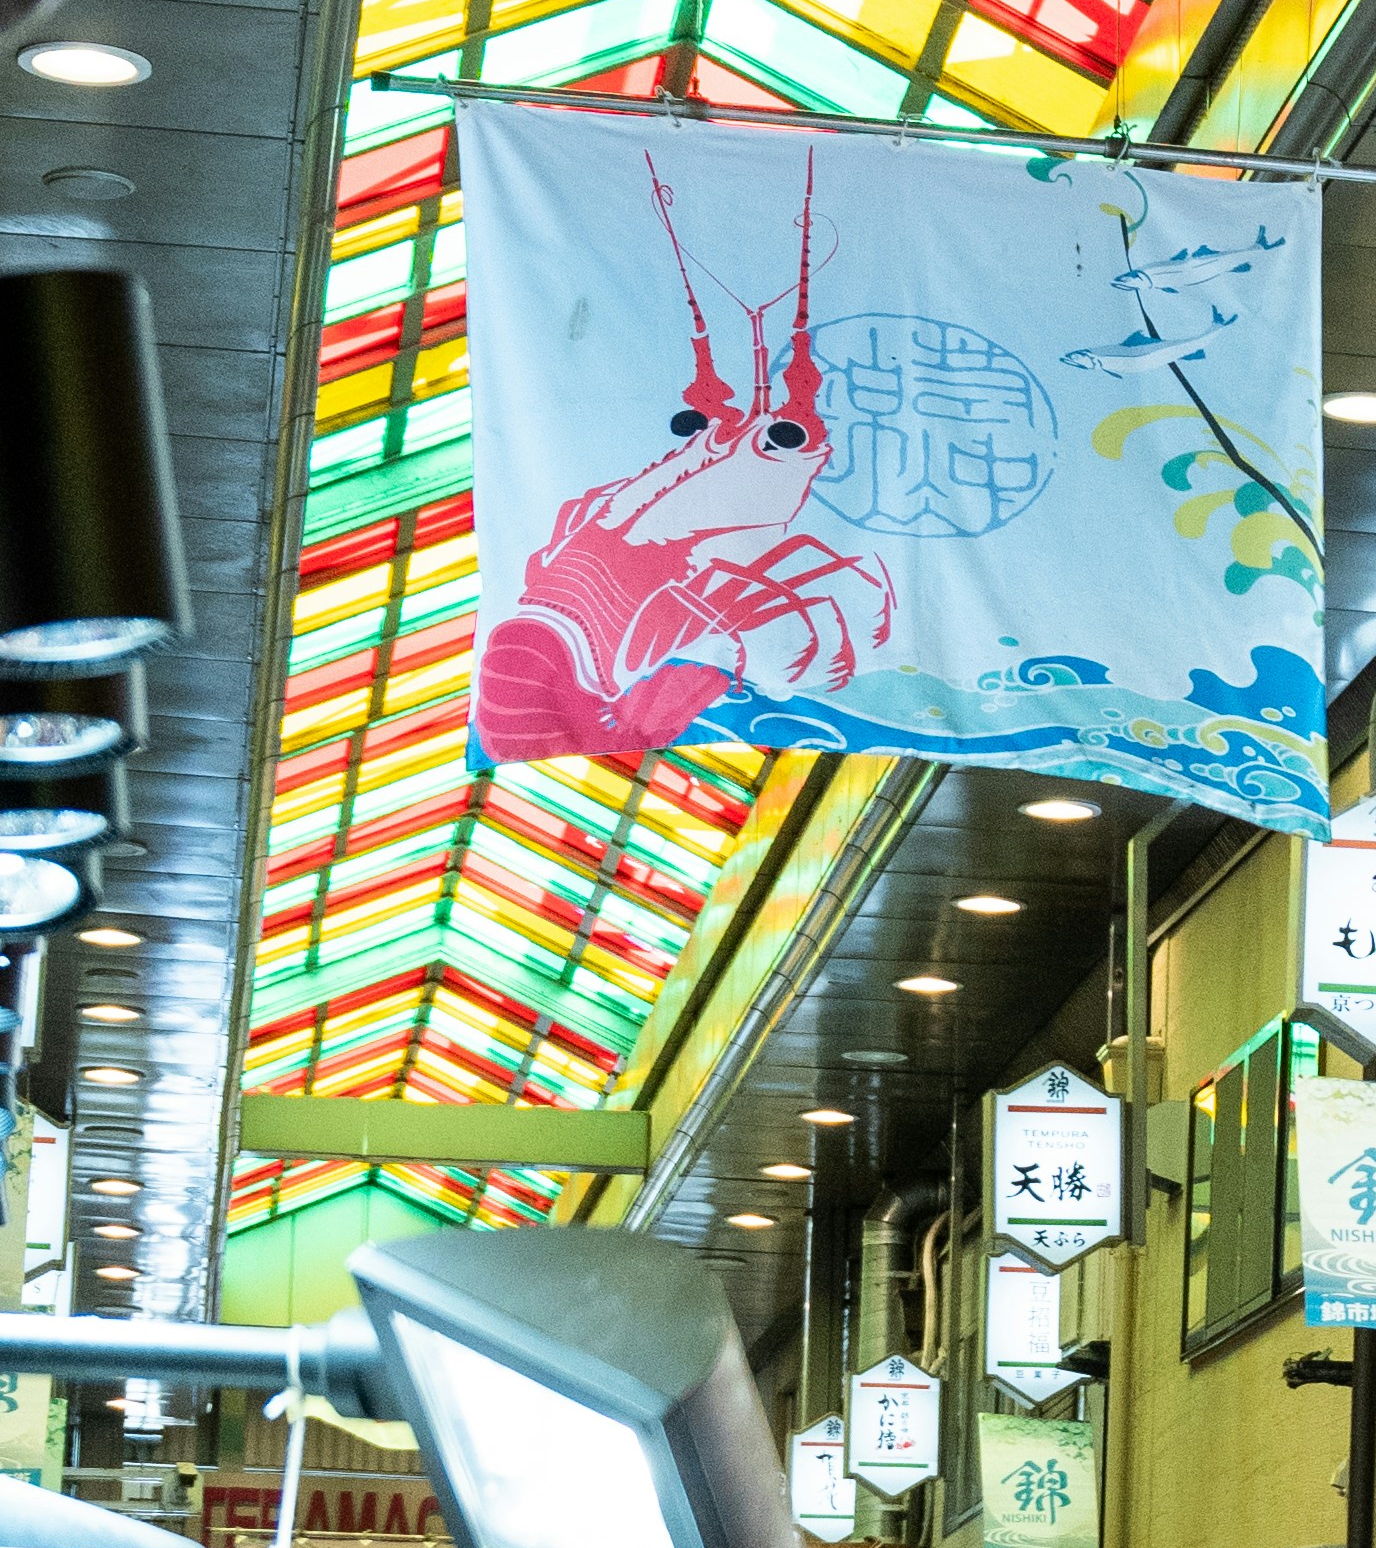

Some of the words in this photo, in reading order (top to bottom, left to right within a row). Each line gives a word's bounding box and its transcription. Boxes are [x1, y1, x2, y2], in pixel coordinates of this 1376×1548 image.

[1023, 1128, 1090, 1138] TEMPURA
[1027, 1140, 1086, 1150] TENSHO
[1006, 1160, 1094, 1203] 天勝
[1031, 1230, 1086, 1248] 天ぷら
[1001, 1458, 1071, 1525] 錦
[1002, 1513, 1047, 1524] NISHIKI
